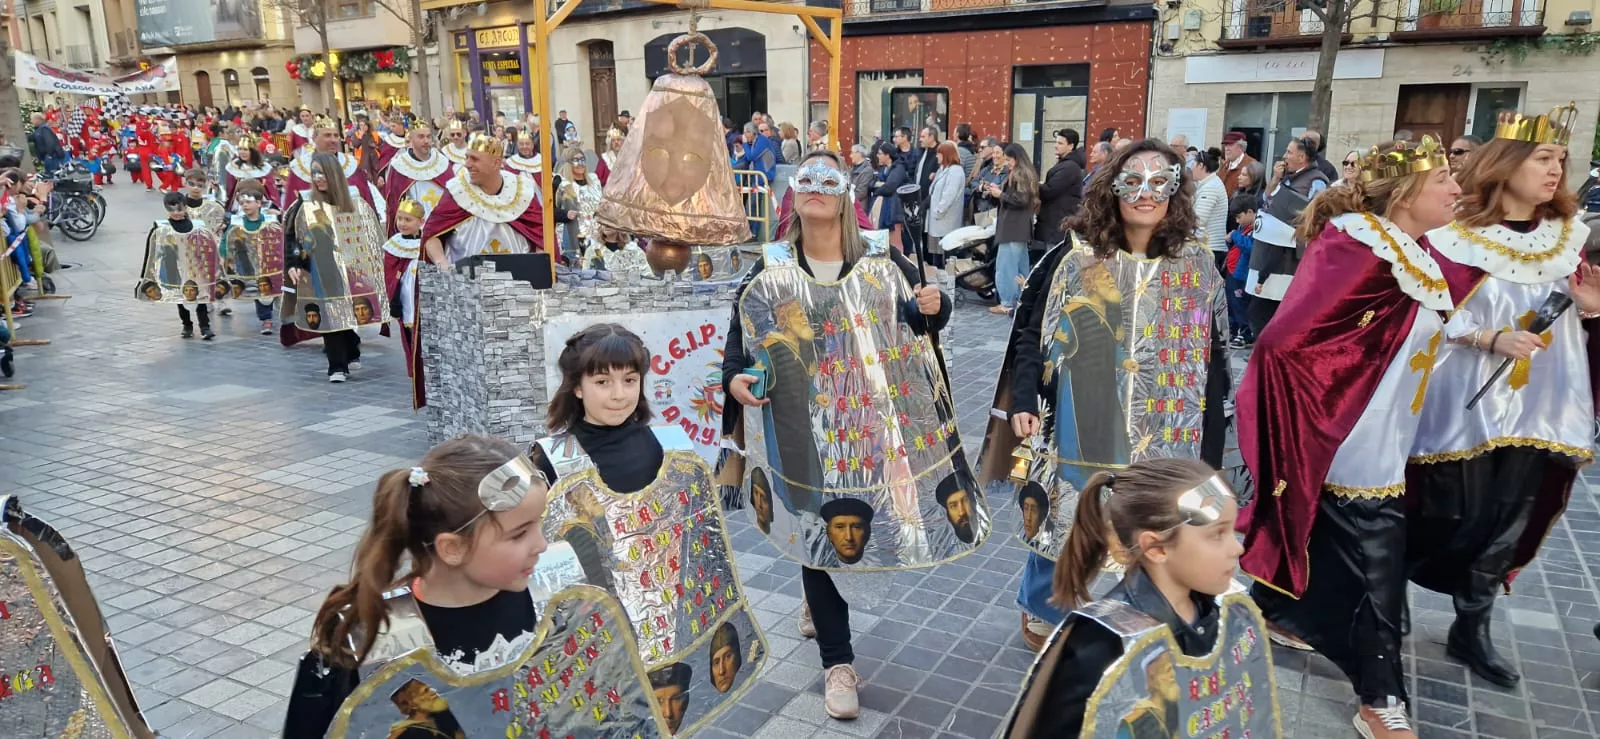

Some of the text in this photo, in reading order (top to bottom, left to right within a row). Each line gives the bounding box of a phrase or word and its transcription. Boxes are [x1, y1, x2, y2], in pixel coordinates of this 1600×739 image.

[1451, 64, 1473, 77] 24
[53, 81, 96, 92] COLEGIO
[1143, 322, 1209, 339] CAMPAN
[650, 322, 724, 377] C.E.I.P.
[1163, 426, 1200, 443] REIN
